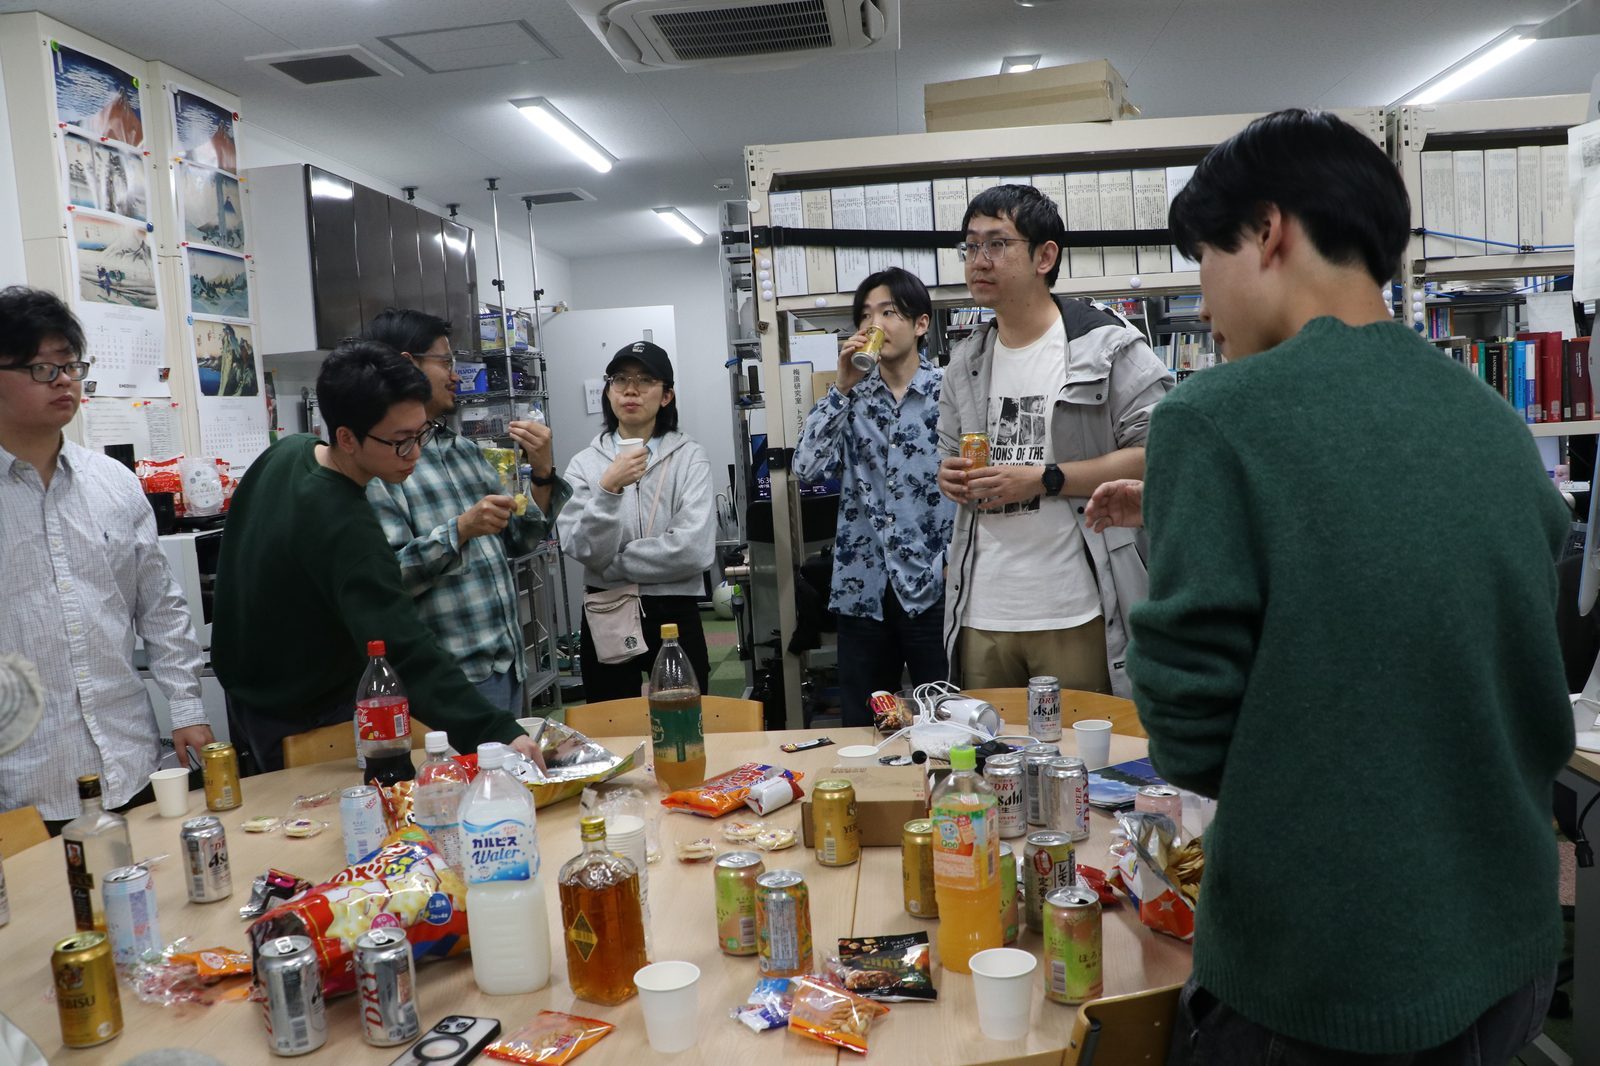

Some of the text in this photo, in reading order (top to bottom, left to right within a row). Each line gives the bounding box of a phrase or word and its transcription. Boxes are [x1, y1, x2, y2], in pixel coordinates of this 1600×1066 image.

[1016, 447, 1027, 461] OF
[1028, 446, 1044, 460] THE
[1033, 704, 1061, 716] Asahi
[997, 789, 1023, 806] sahi
[472, 836, 518, 849] カルピス
[941, 839, 958, 849] Qoo
[471, 848, 520, 865] Water
